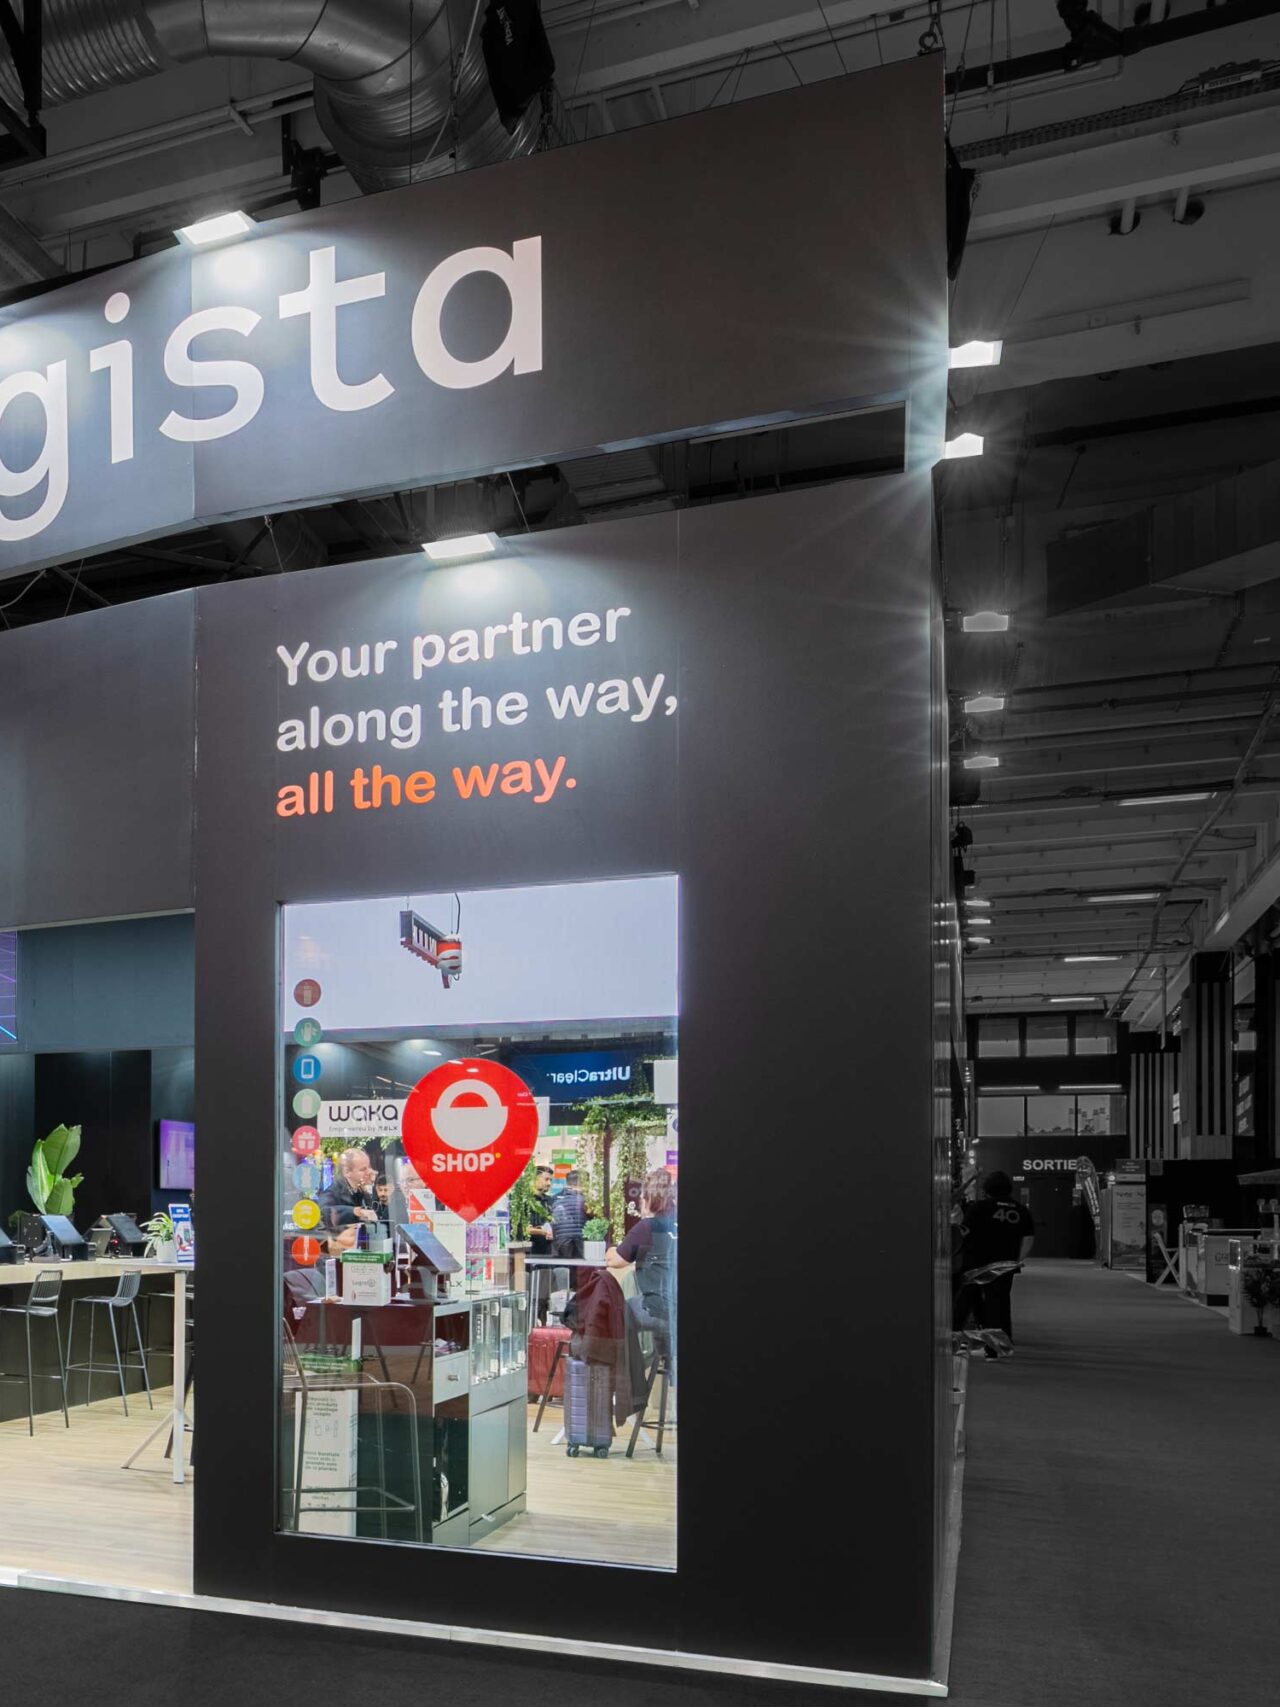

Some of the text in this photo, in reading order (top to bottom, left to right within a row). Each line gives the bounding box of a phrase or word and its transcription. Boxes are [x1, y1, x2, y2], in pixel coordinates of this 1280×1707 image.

[276, 606, 632, 687] Your partner
[276, 673, 678, 752] along the way,
[276, 755, 577, 817] all the way.
[431, 1152, 495, 1173] SHOP
[1022, 1159, 1077, 1170] SORTIE
[992, 1209, 1021, 1224] 40
